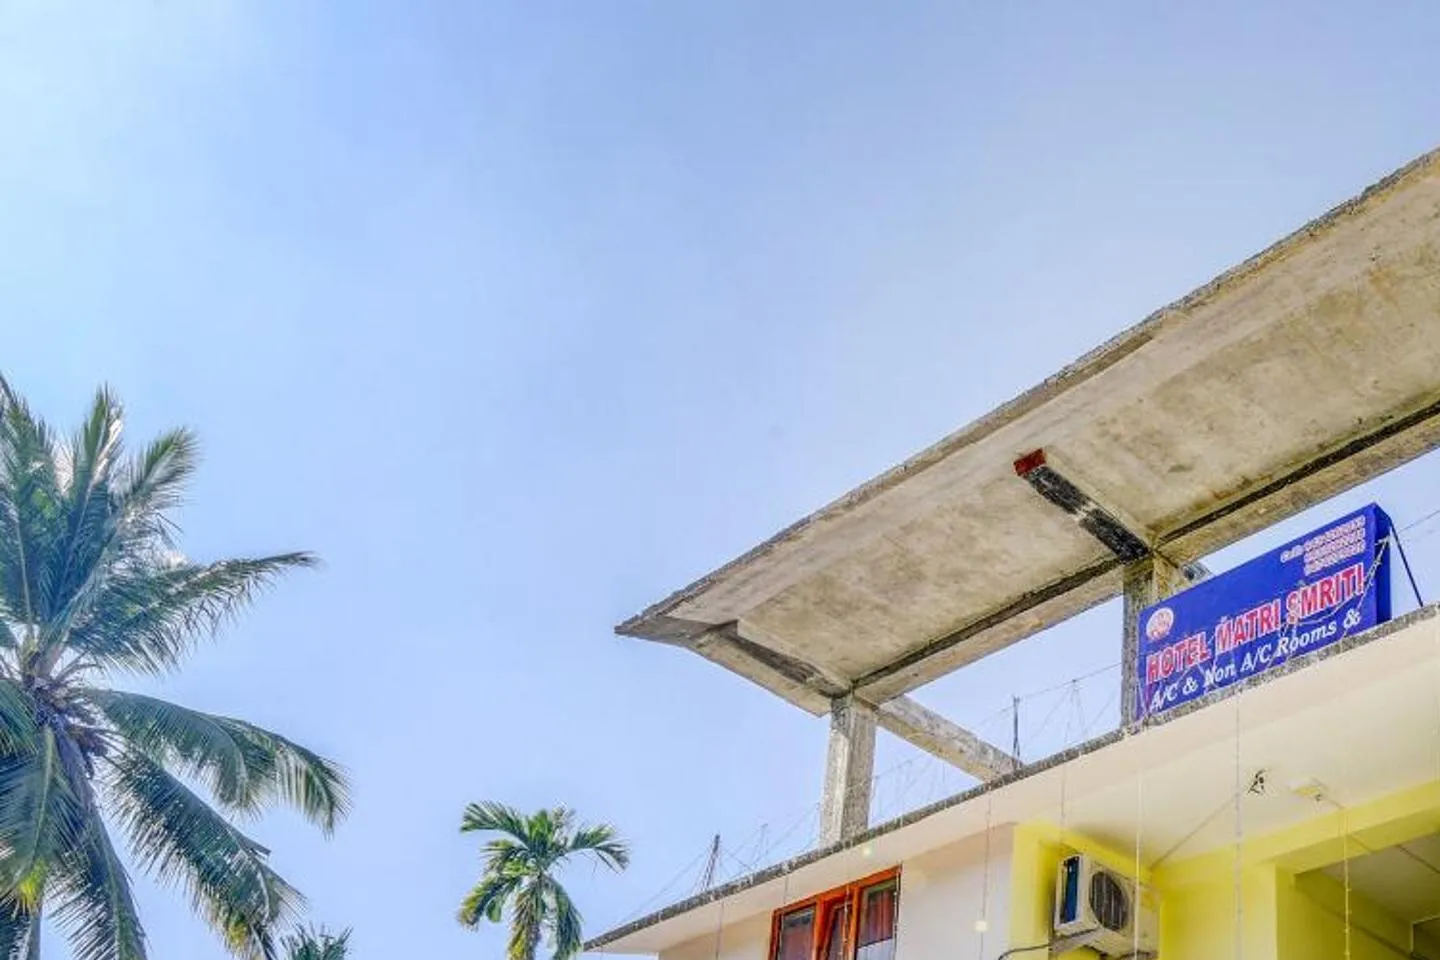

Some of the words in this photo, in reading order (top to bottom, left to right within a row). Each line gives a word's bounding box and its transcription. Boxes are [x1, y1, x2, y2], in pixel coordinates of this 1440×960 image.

[1146, 632, 1211, 685] HOTEL
[1215, 598, 1281, 655] MATRI
[1286, 562, 1364, 624] SMRITI
[1149, 682, 1178, 712] A/C
[1182, 677, 1198, 695] &
[1204, 664, 1236, 687] Non
[1240, 644, 1271, 672] A/C
[1276, 621, 1337, 656] Rooms
[1343, 608, 1360, 628] &
